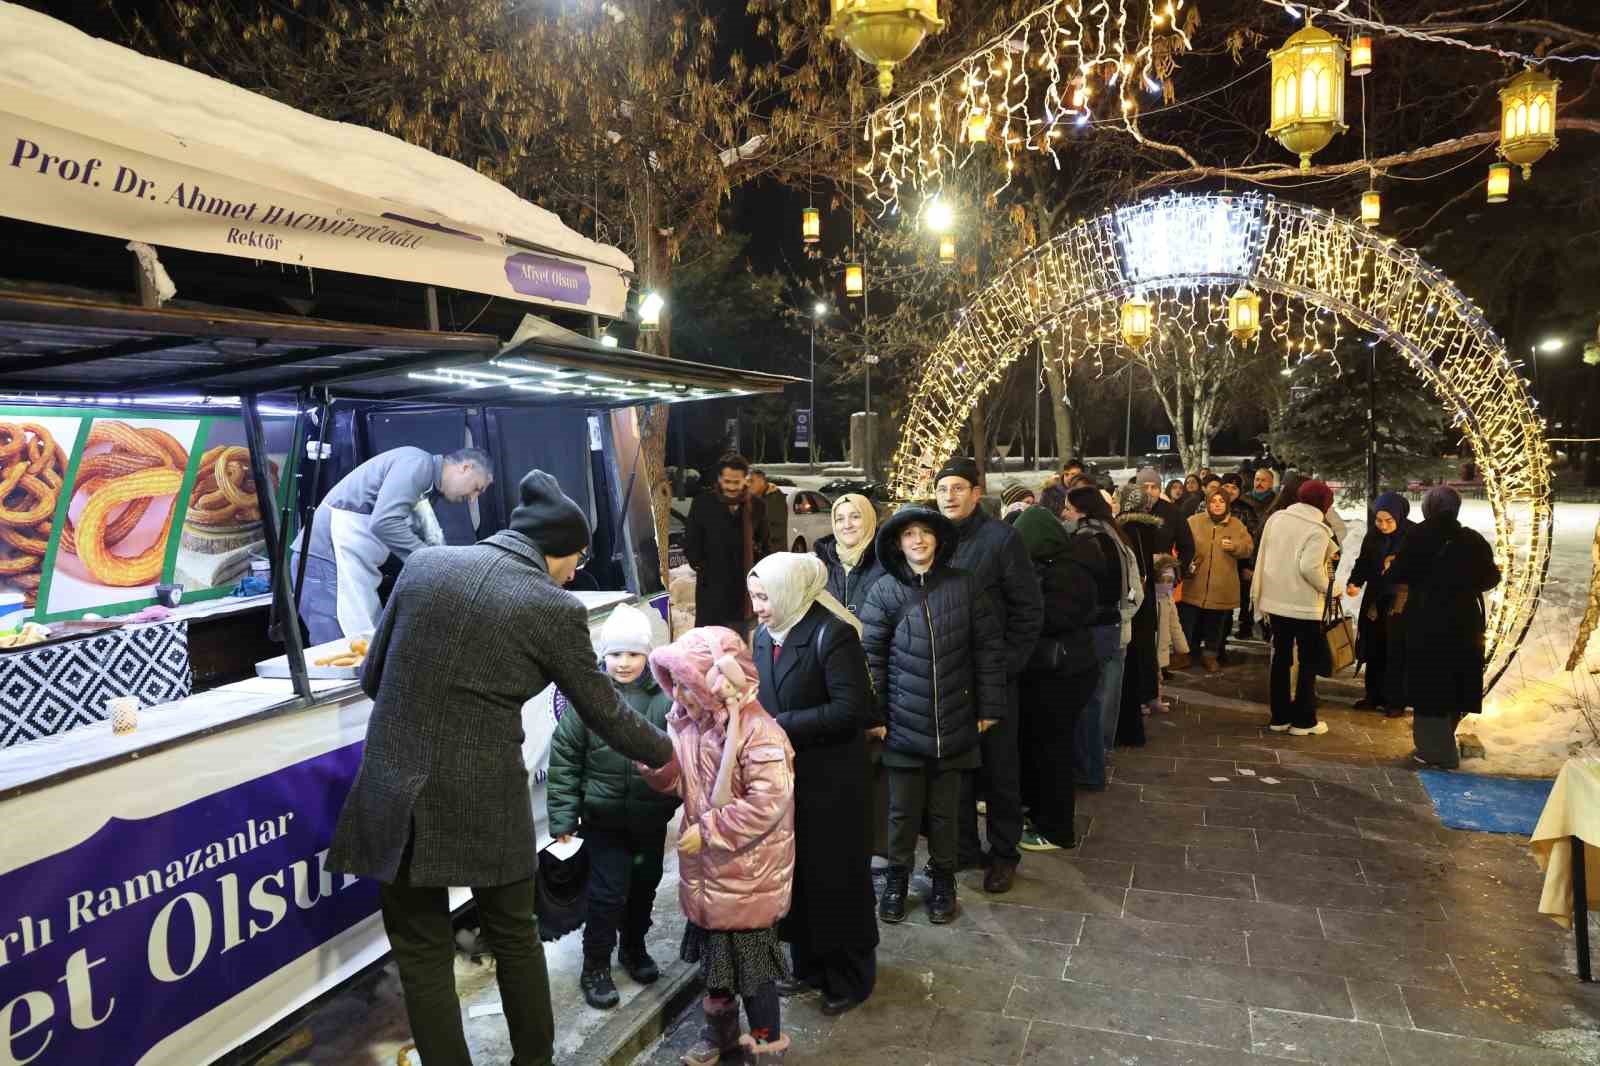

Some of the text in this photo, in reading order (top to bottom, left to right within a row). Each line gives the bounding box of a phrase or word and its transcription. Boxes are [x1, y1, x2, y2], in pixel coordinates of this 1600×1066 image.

[9, 137, 102, 187] Prof.
[113, 166, 157, 201] Dr.
[165, 182, 259, 222] Ahmet
[226, 227, 283, 251] Rektör
[68, 811, 294, 933] Ramazanlar
[148, 847, 360, 983] Olsu
